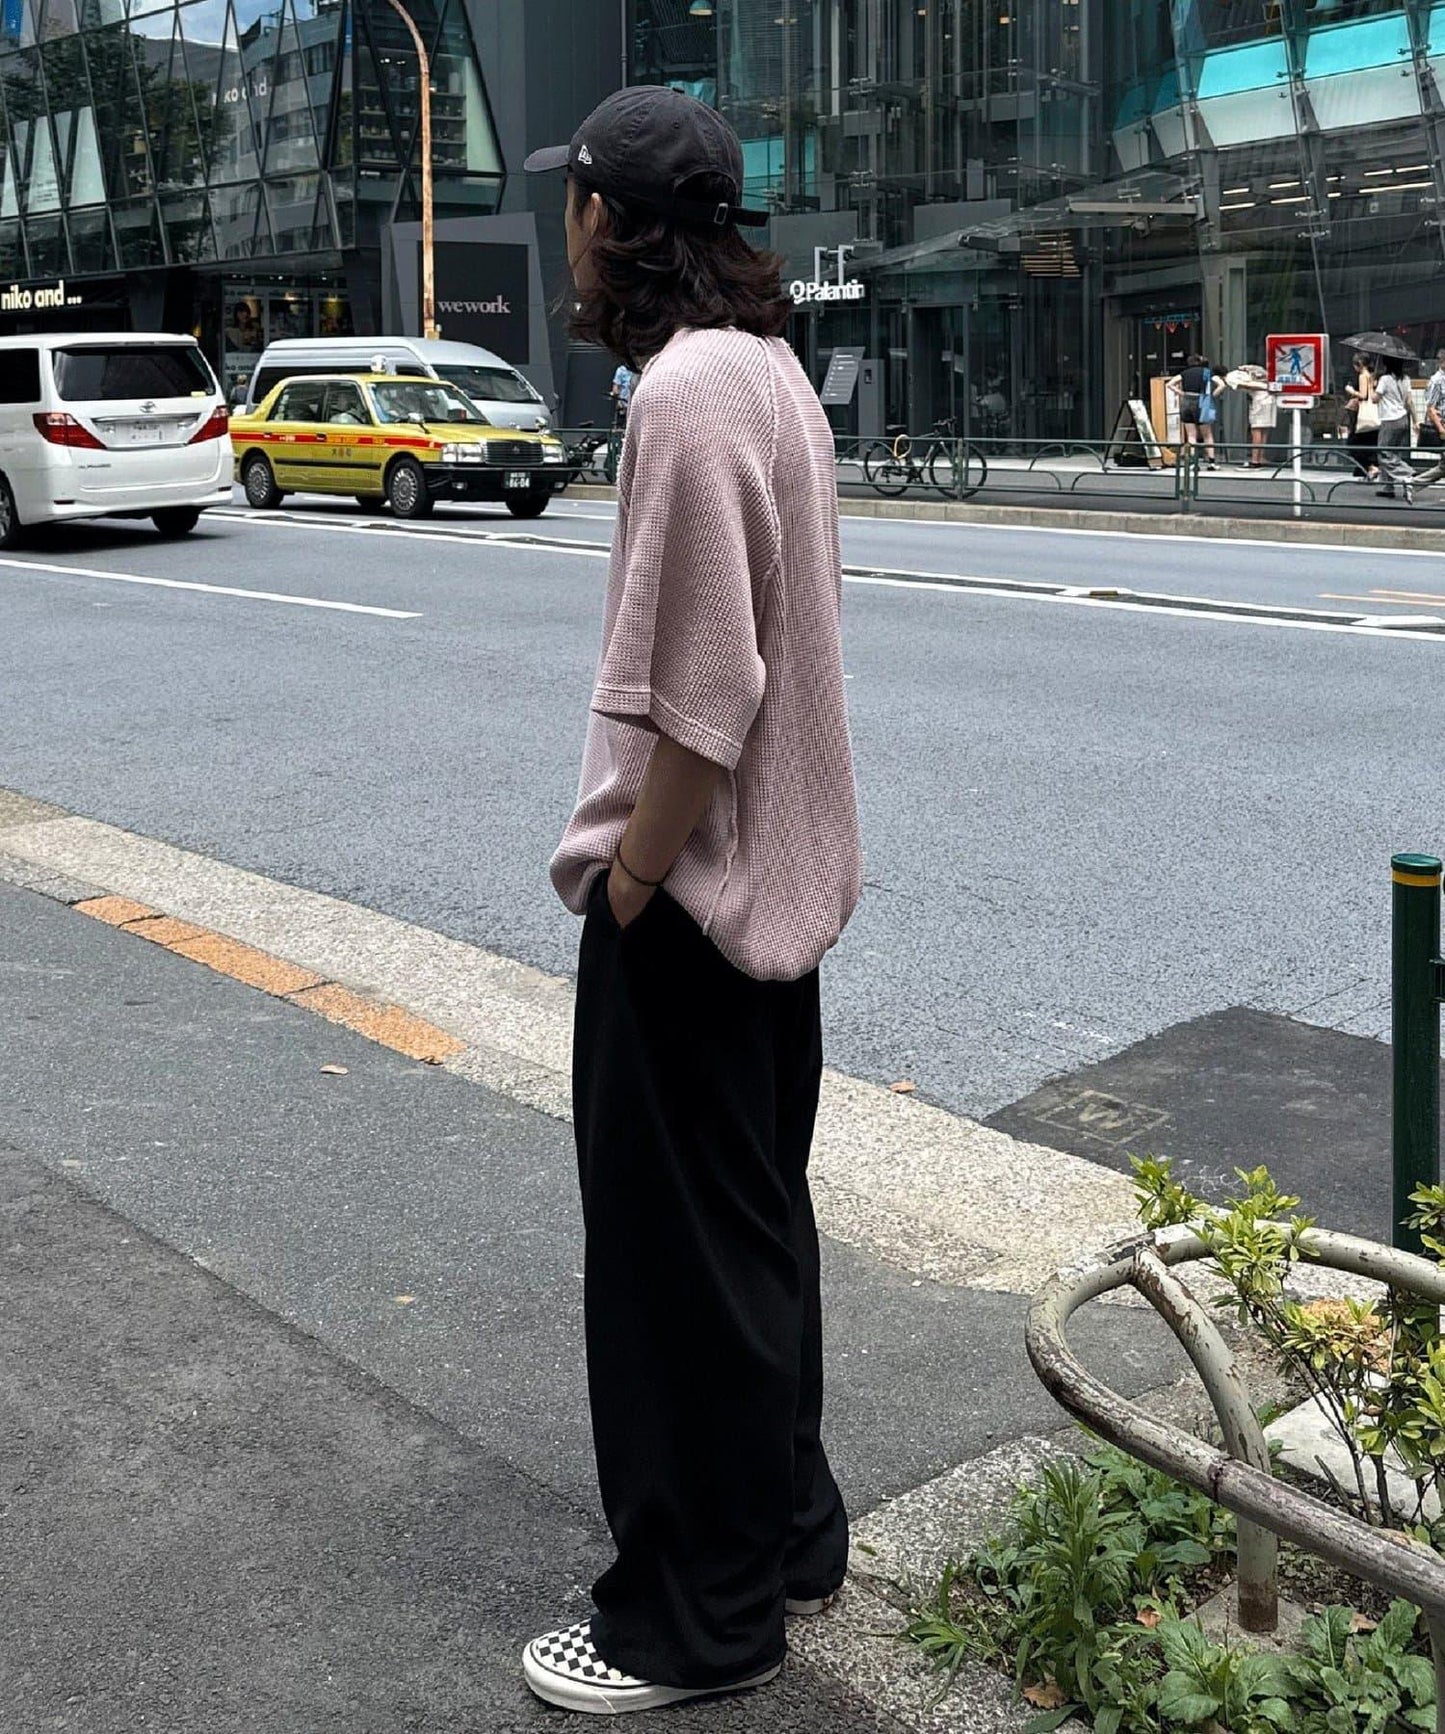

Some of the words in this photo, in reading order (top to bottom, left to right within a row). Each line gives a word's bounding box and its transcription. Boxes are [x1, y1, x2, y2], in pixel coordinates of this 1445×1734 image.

[1, 284, 32, 310] niko
[34, 279, 65, 308] and
[437, 294, 511, 314] wework
